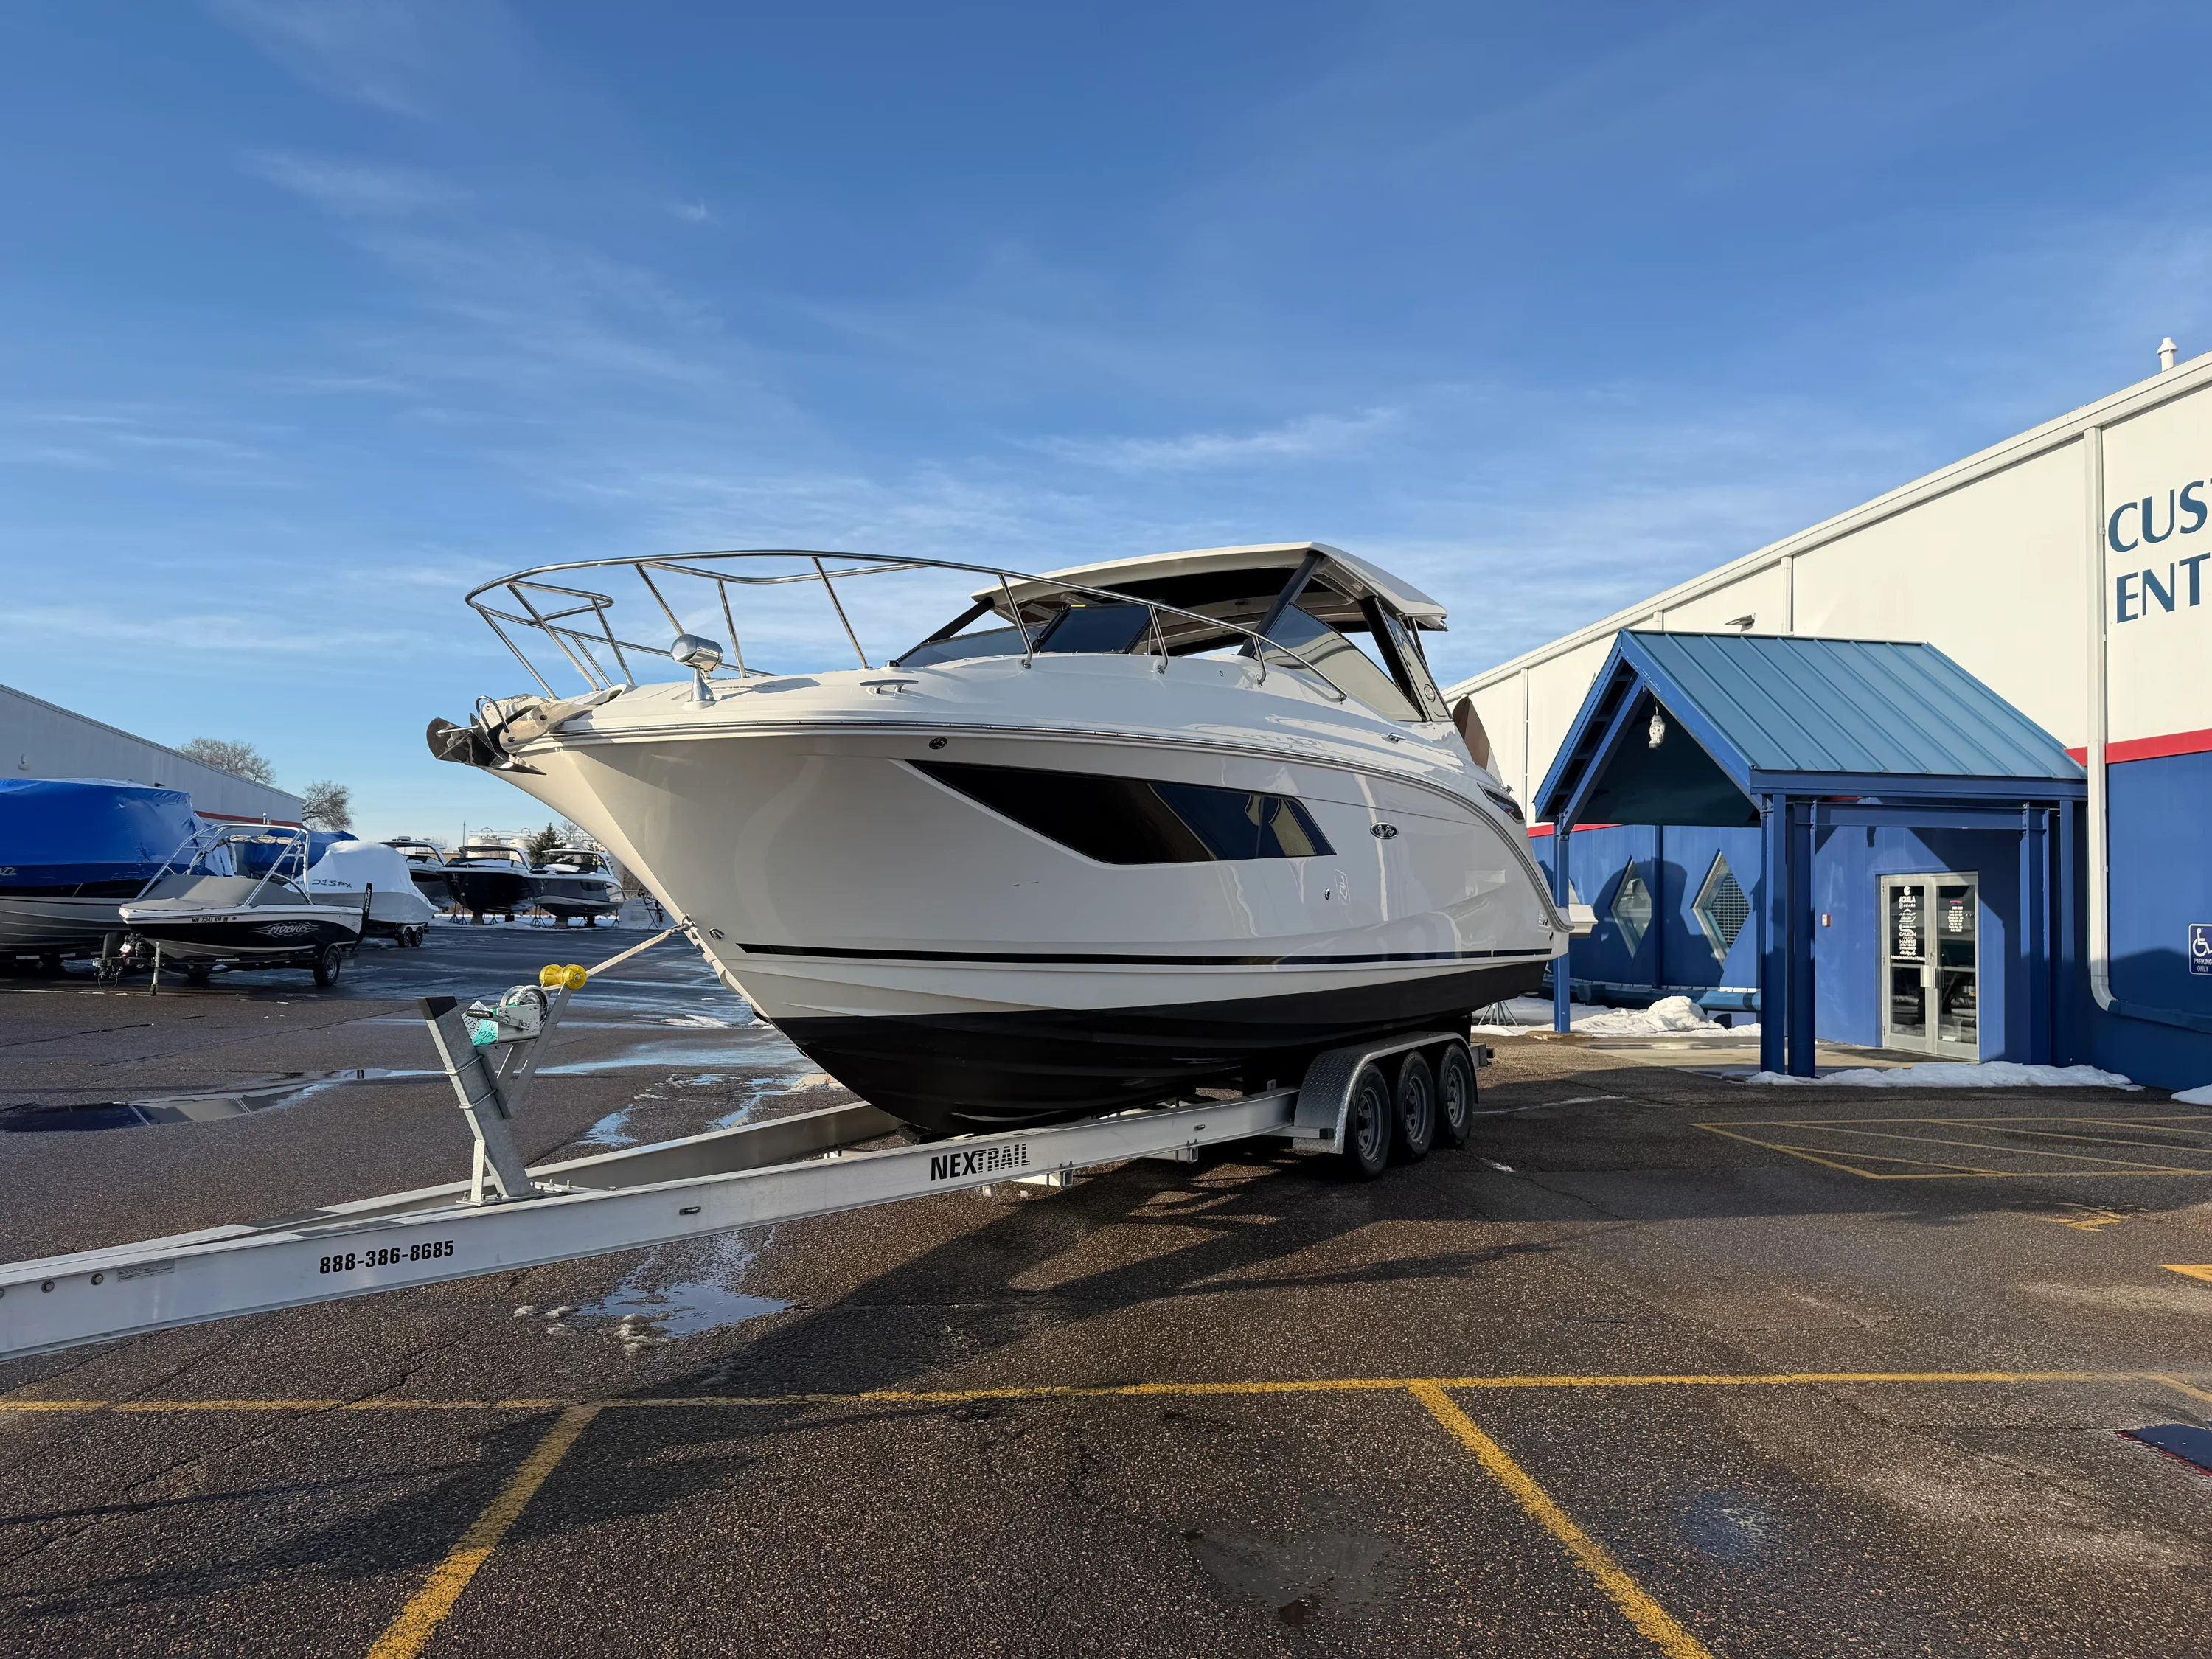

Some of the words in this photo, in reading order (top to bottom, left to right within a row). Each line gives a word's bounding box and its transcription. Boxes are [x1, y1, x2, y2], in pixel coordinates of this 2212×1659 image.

[2108, 478, 2212, 552] CUS
[2116, 552, 2211, 624] ENT
[268, 925, 307, 933] MOBIUS
[931, 1143, 1031, 1181] NEXTRAIL
[319, 1240, 453, 1274] 888-386-8685
